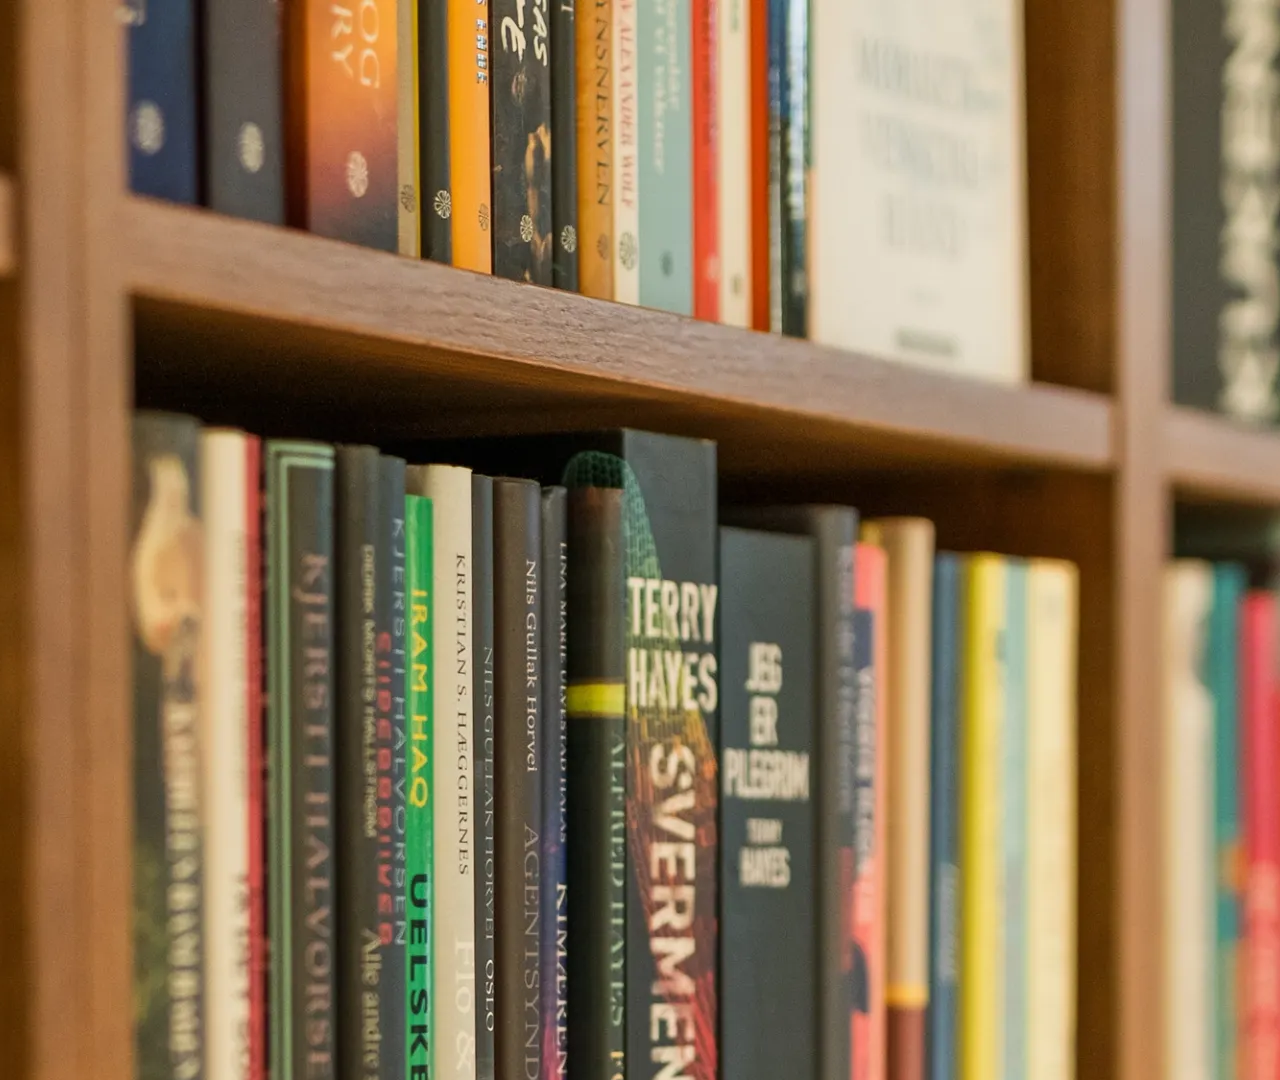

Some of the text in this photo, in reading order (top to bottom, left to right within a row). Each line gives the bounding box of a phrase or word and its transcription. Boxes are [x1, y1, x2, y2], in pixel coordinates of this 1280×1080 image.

[620, 20, 634, 146] ALEXANDER
[620, 154, 634, 210] WOLF
[627, 577, 717, 643] TERRY
[291, 553, 330, 767] KJERSTI
[525, 559, 538, 771] Nils Gullak Horvei
[626, 648, 717, 713] HAYES
[745, 641, 782, 694] JEG
[392, 518, 407, 945] KJERSTI HALVORSEN
[409, 589, 428, 809] IRAM HAQ
[456, 553, 470, 875] KRISTIAN S. HÆGGERNES
[750, 698, 778, 746] ER
[723, 748, 809, 801] PILEGRIM
[484, 647, 494, 1032] NILS GULLAK HORVEI OSLO
[739, 846, 790, 888] HAYES
[610, 732, 625, 1026] ALFRED HAYES
[360, 928, 383, 984] Alle
[453, 937, 474, 1013] Flo
[361, 990, 380, 1068] andre
[455, 1031, 474, 1071] &
